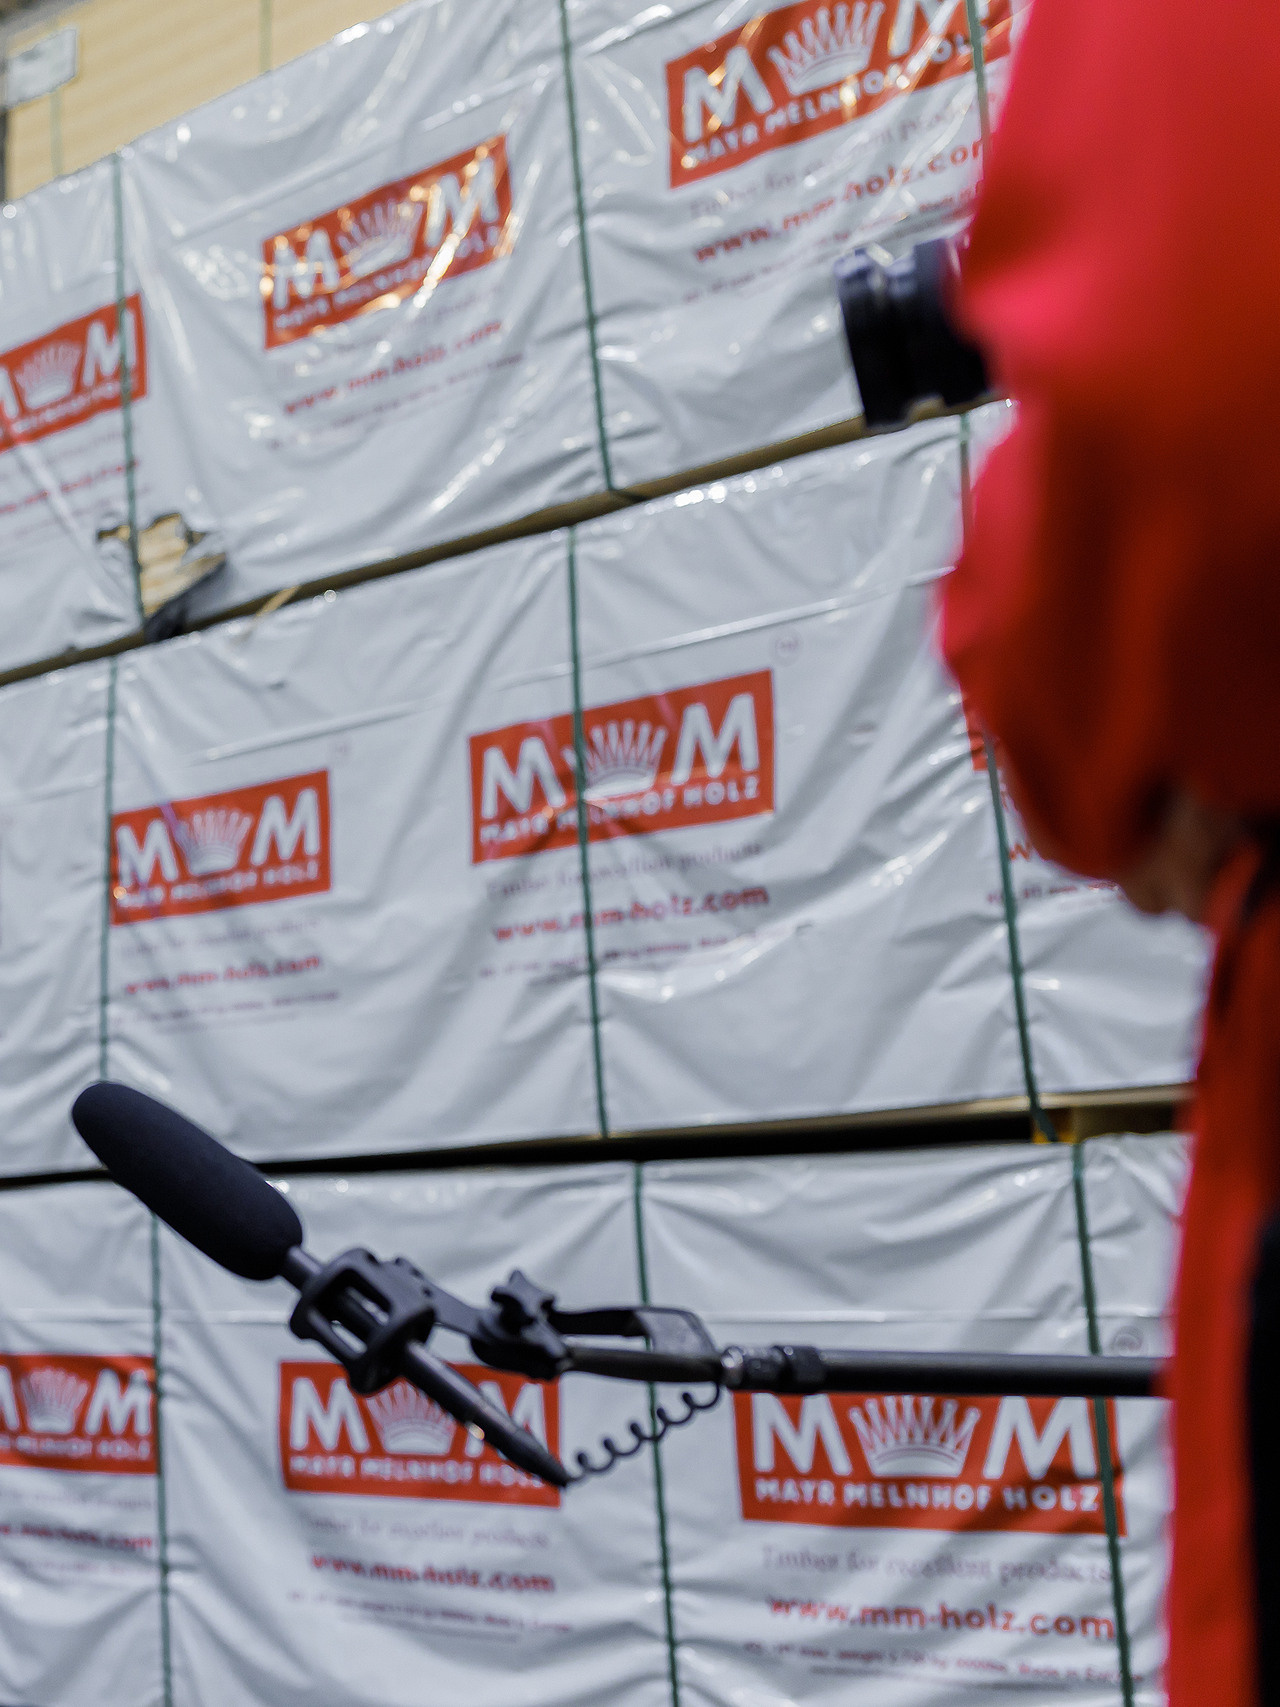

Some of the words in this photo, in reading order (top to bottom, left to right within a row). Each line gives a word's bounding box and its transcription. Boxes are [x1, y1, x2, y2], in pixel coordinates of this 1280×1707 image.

[683, 46, 773, 143] M
[273, 228, 340, 311] M
[423, 157, 500, 248] M
[480, 736, 566, 819] M
[671, 693, 760, 786] M
[116, 819, 178, 888] M
[251, 788, 319, 867] M
[84, 1368, 151, 1436] M
[290, 1377, 369, 1451] M
[751, 1393, 853, 1475] M
[983, 1396, 1098, 1480] M
[754, 1478, 835, 1506] MAYR
[843, 1482, 991, 1512] MELNHOF
[1002, 1484, 1102, 1513] HOLZ
[770, 1597, 1116, 1641] www.mm-holz.com
